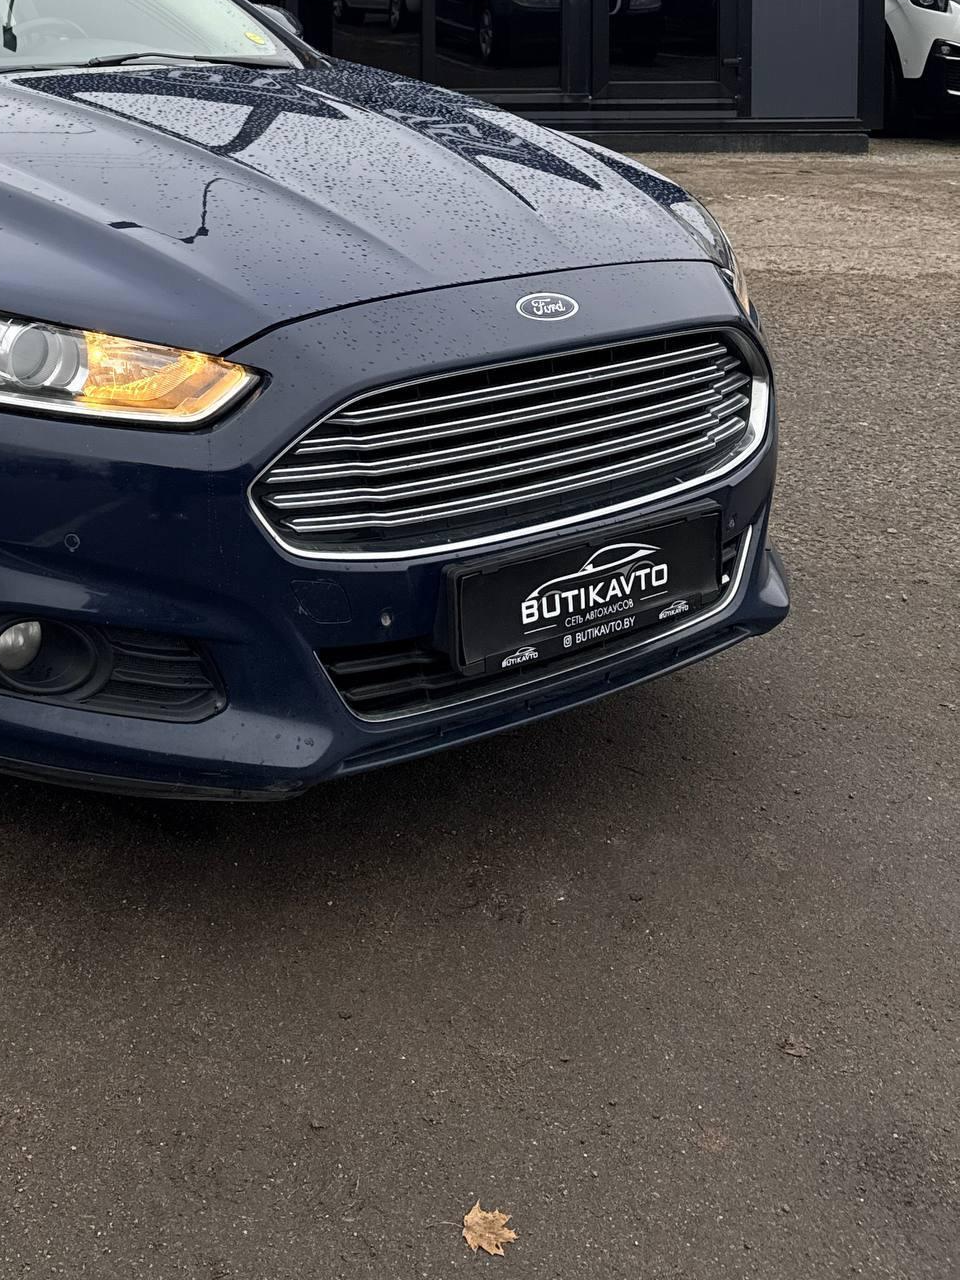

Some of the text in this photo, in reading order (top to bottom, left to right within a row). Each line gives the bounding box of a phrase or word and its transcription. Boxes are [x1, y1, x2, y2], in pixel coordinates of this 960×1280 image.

[531, 298, 566, 315] Ford
[521, 563, 668, 625] BUTIKAVTO
[565, 599, 634, 627] СЕТЬ АВТОХАУСОВ
[576, 616, 635, 643] BUTIKAVTO.BY
